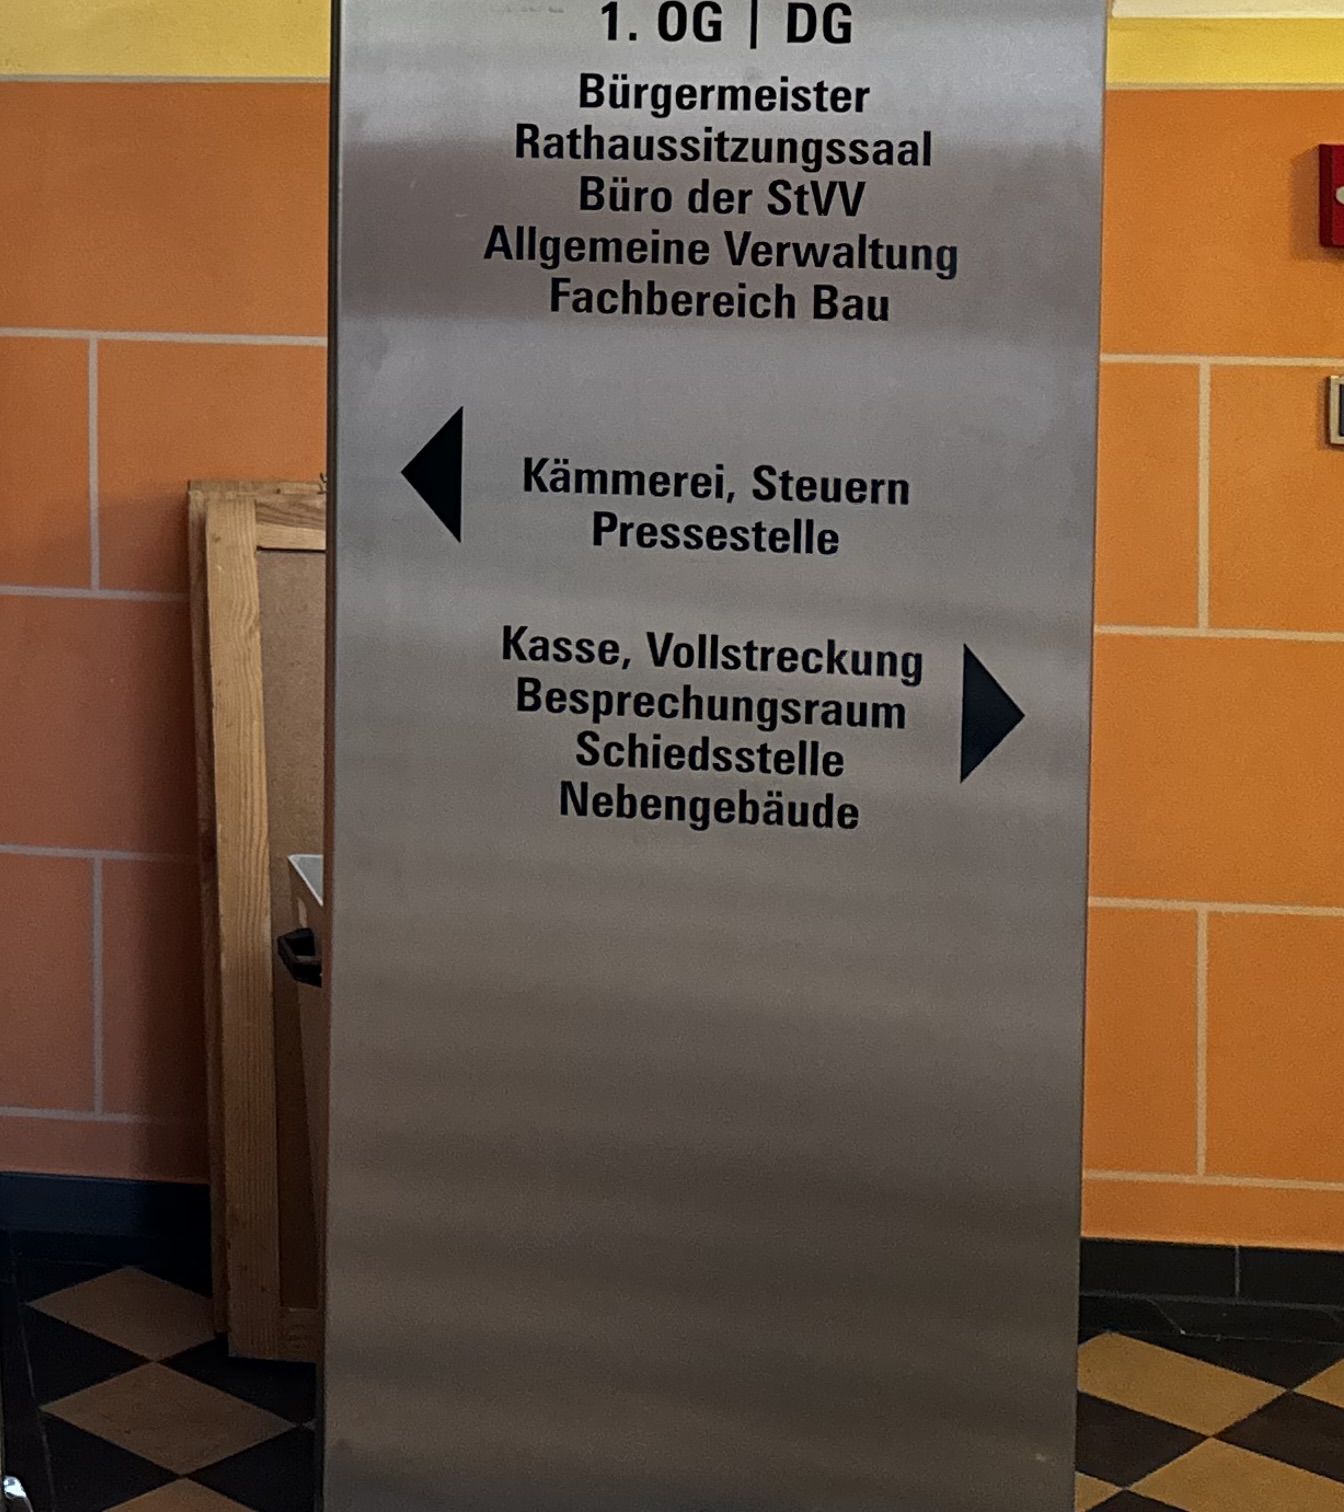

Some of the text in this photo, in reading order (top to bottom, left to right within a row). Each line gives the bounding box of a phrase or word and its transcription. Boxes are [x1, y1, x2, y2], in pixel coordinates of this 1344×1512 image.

[602, 1, 638, 42] 1.
[657, 0, 723, 43] OG
[786, 2, 853, 45] DG
[578, 73, 871, 118] Bürgermeister
[515, 123, 932, 173] Rathaussitzungssaal
[578, 175, 867, 218] Büro der StVV
[483, 225, 959, 280] Allgemeine Verwaltung
[550, 277, 890, 322] Fachbereich Bau
[523, 457, 911, 506] Kämmerei, Steuern
[592, 511, 840, 556] Pressestelle
[502, 625, 923, 686] Kasse, Vollstreckung
[516, 678, 907, 732] Besprechungsraum
[575, 731, 845, 778] Schiedsstelle
[560, 780, 860, 832] Nebengebäude
